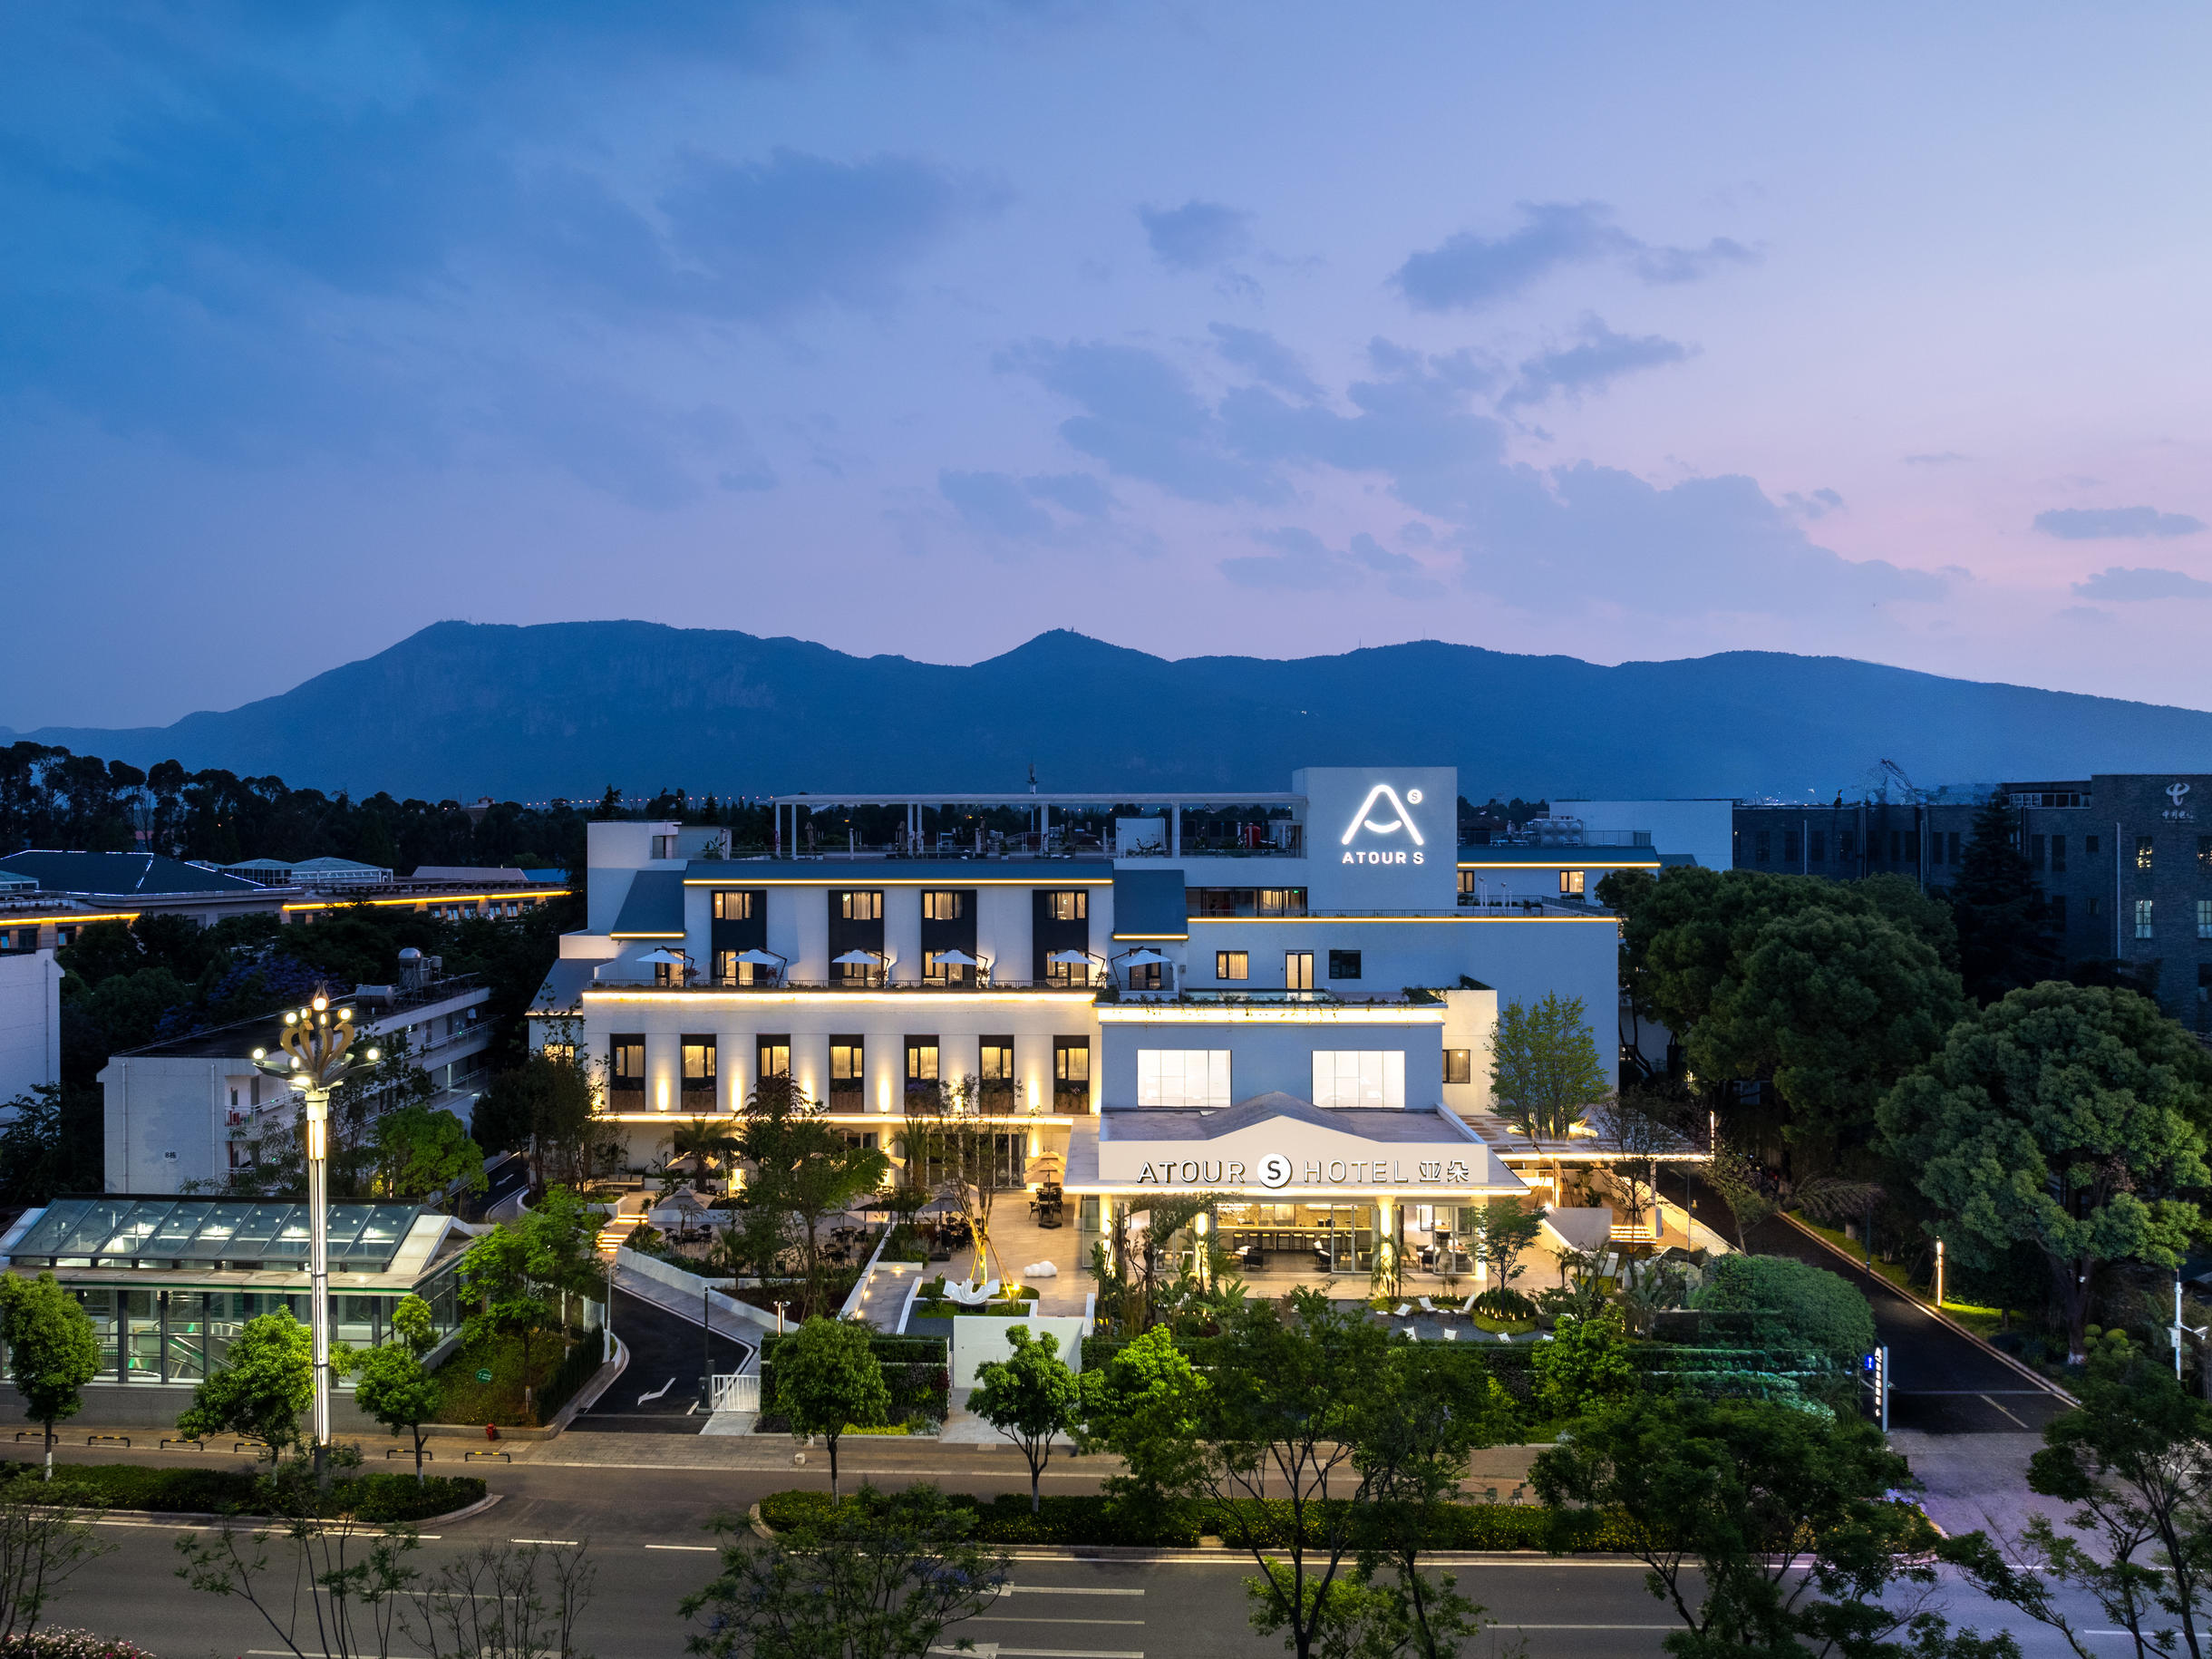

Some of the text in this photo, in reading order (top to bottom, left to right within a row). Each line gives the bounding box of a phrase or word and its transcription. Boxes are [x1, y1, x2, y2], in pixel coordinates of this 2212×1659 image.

[1342, 851, 1424, 864] ATOUR S
[1137, 1159, 1247, 1183] ATOUR
[1304, 1159, 1408, 1183] HOTEL
[1419, 1159, 1470, 1182] 亚朵
